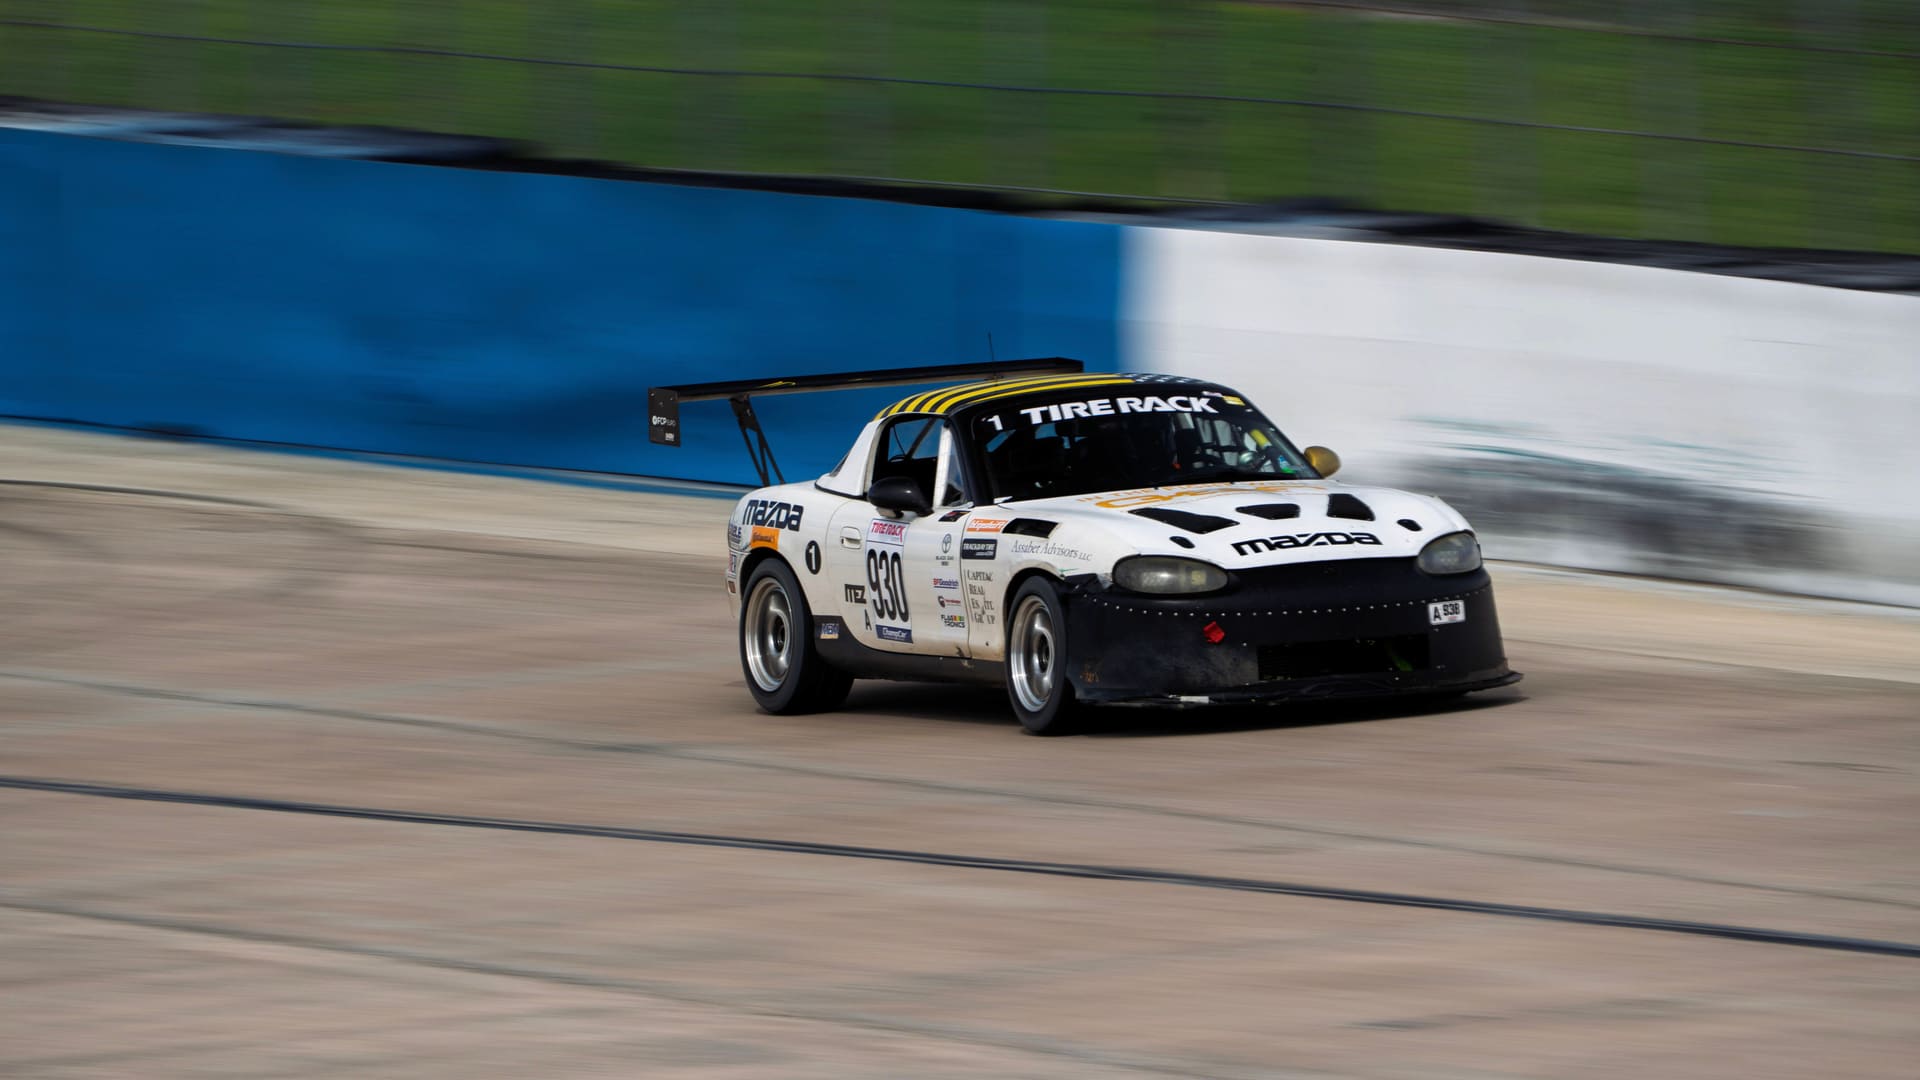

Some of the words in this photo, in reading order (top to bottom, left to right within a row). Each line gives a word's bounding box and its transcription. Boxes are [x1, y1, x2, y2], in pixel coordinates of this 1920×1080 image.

[987, 415, 1003, 430] 1
[1020, 399, 1115, 425] TIRE
[1117, 396, 1218, 414] RACK
[871, 522, 886, 534] TIRE
[808, 545, 816, 571] 1
[1040, 541, 1078, 558] Advisors
[867, 548, 909, 622] 930
[864, 609, 872, 632] A
[1433, 606, 1442, 621] A
